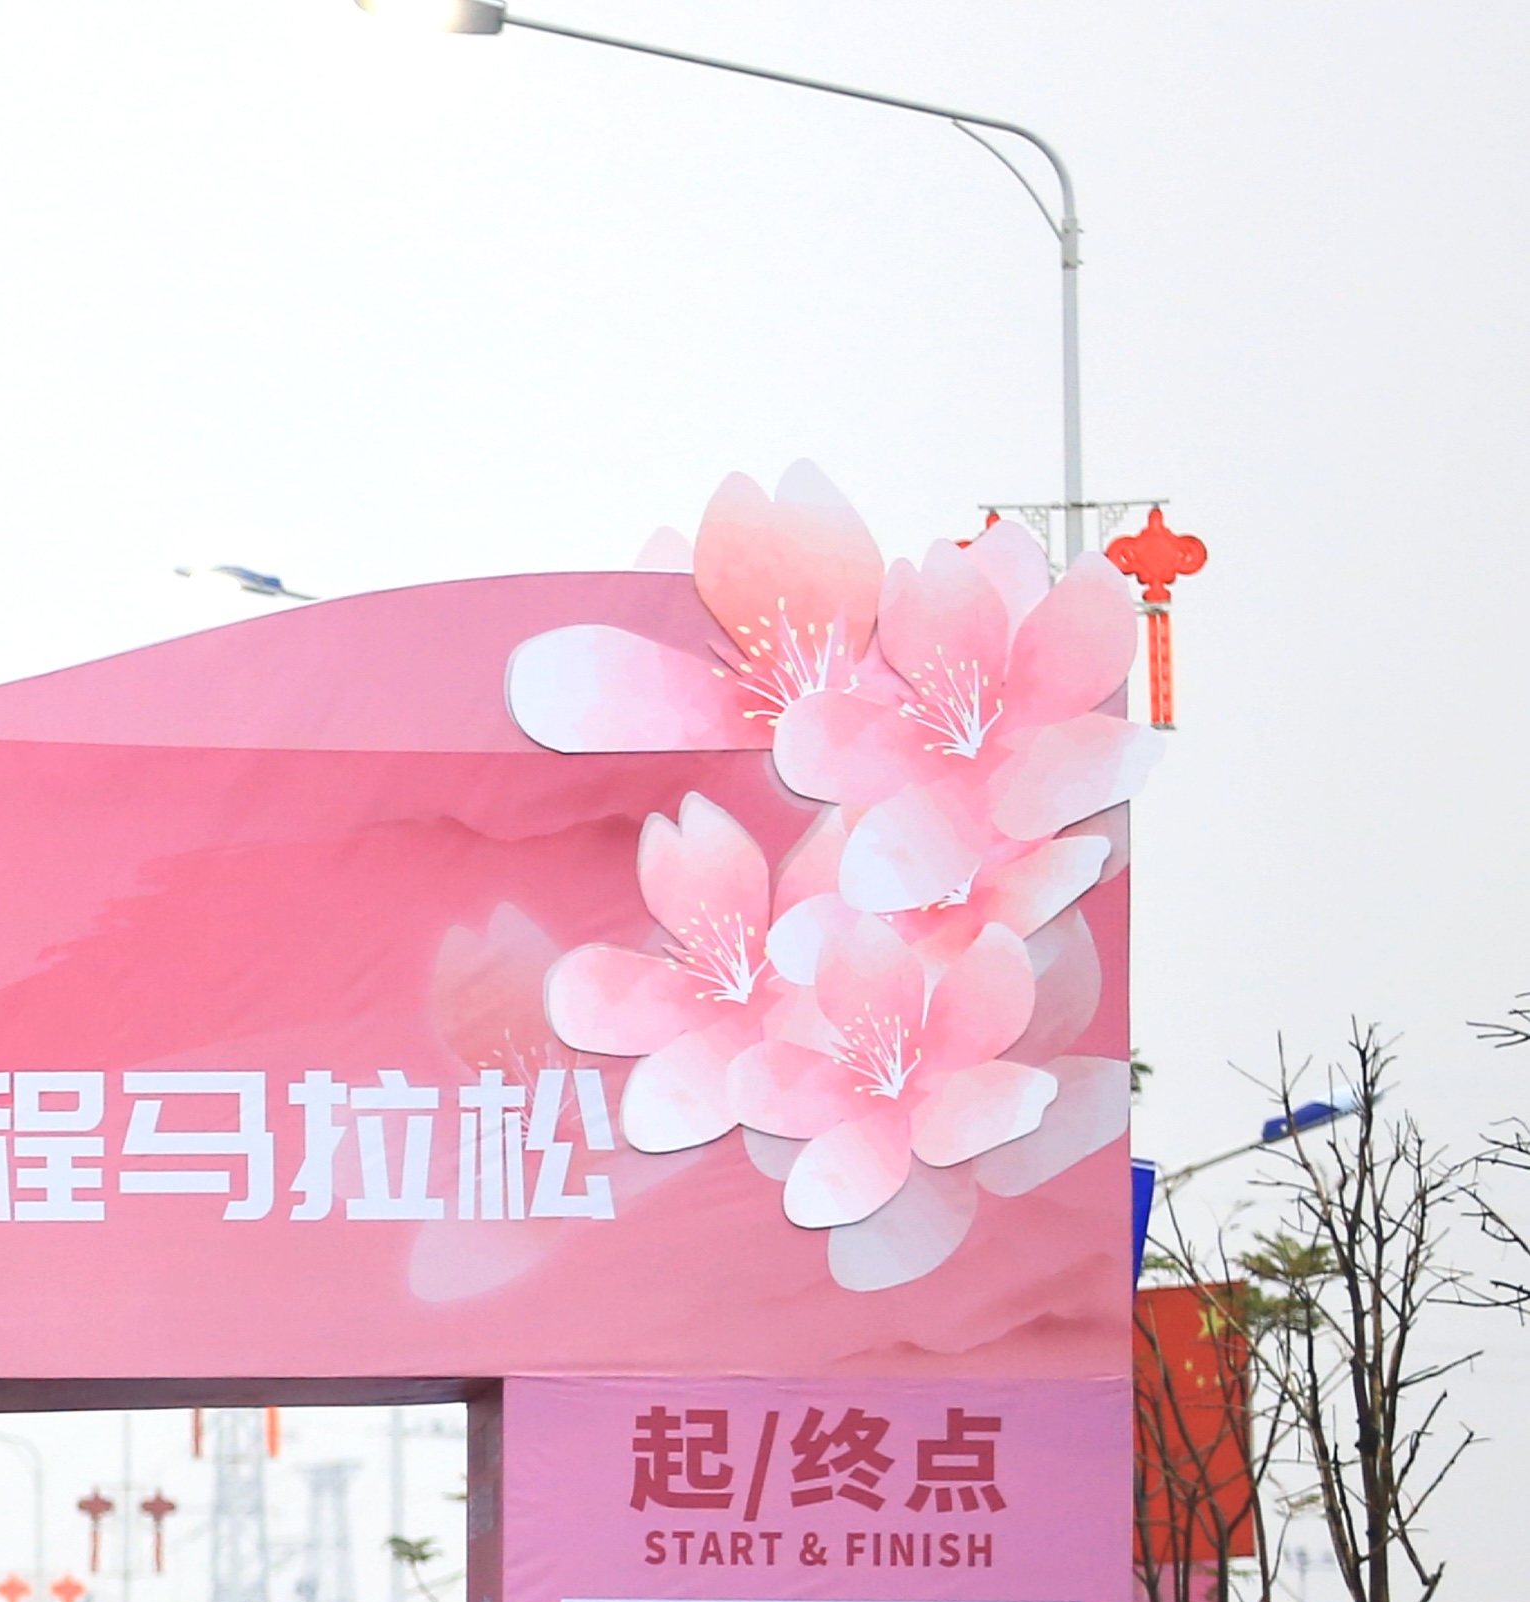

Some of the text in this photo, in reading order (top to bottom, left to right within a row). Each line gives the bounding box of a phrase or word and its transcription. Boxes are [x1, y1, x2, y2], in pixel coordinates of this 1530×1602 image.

[627, 1405, 1008, 1522] 起/终点
[644, 1531, 995, 1569] START & FINISH
